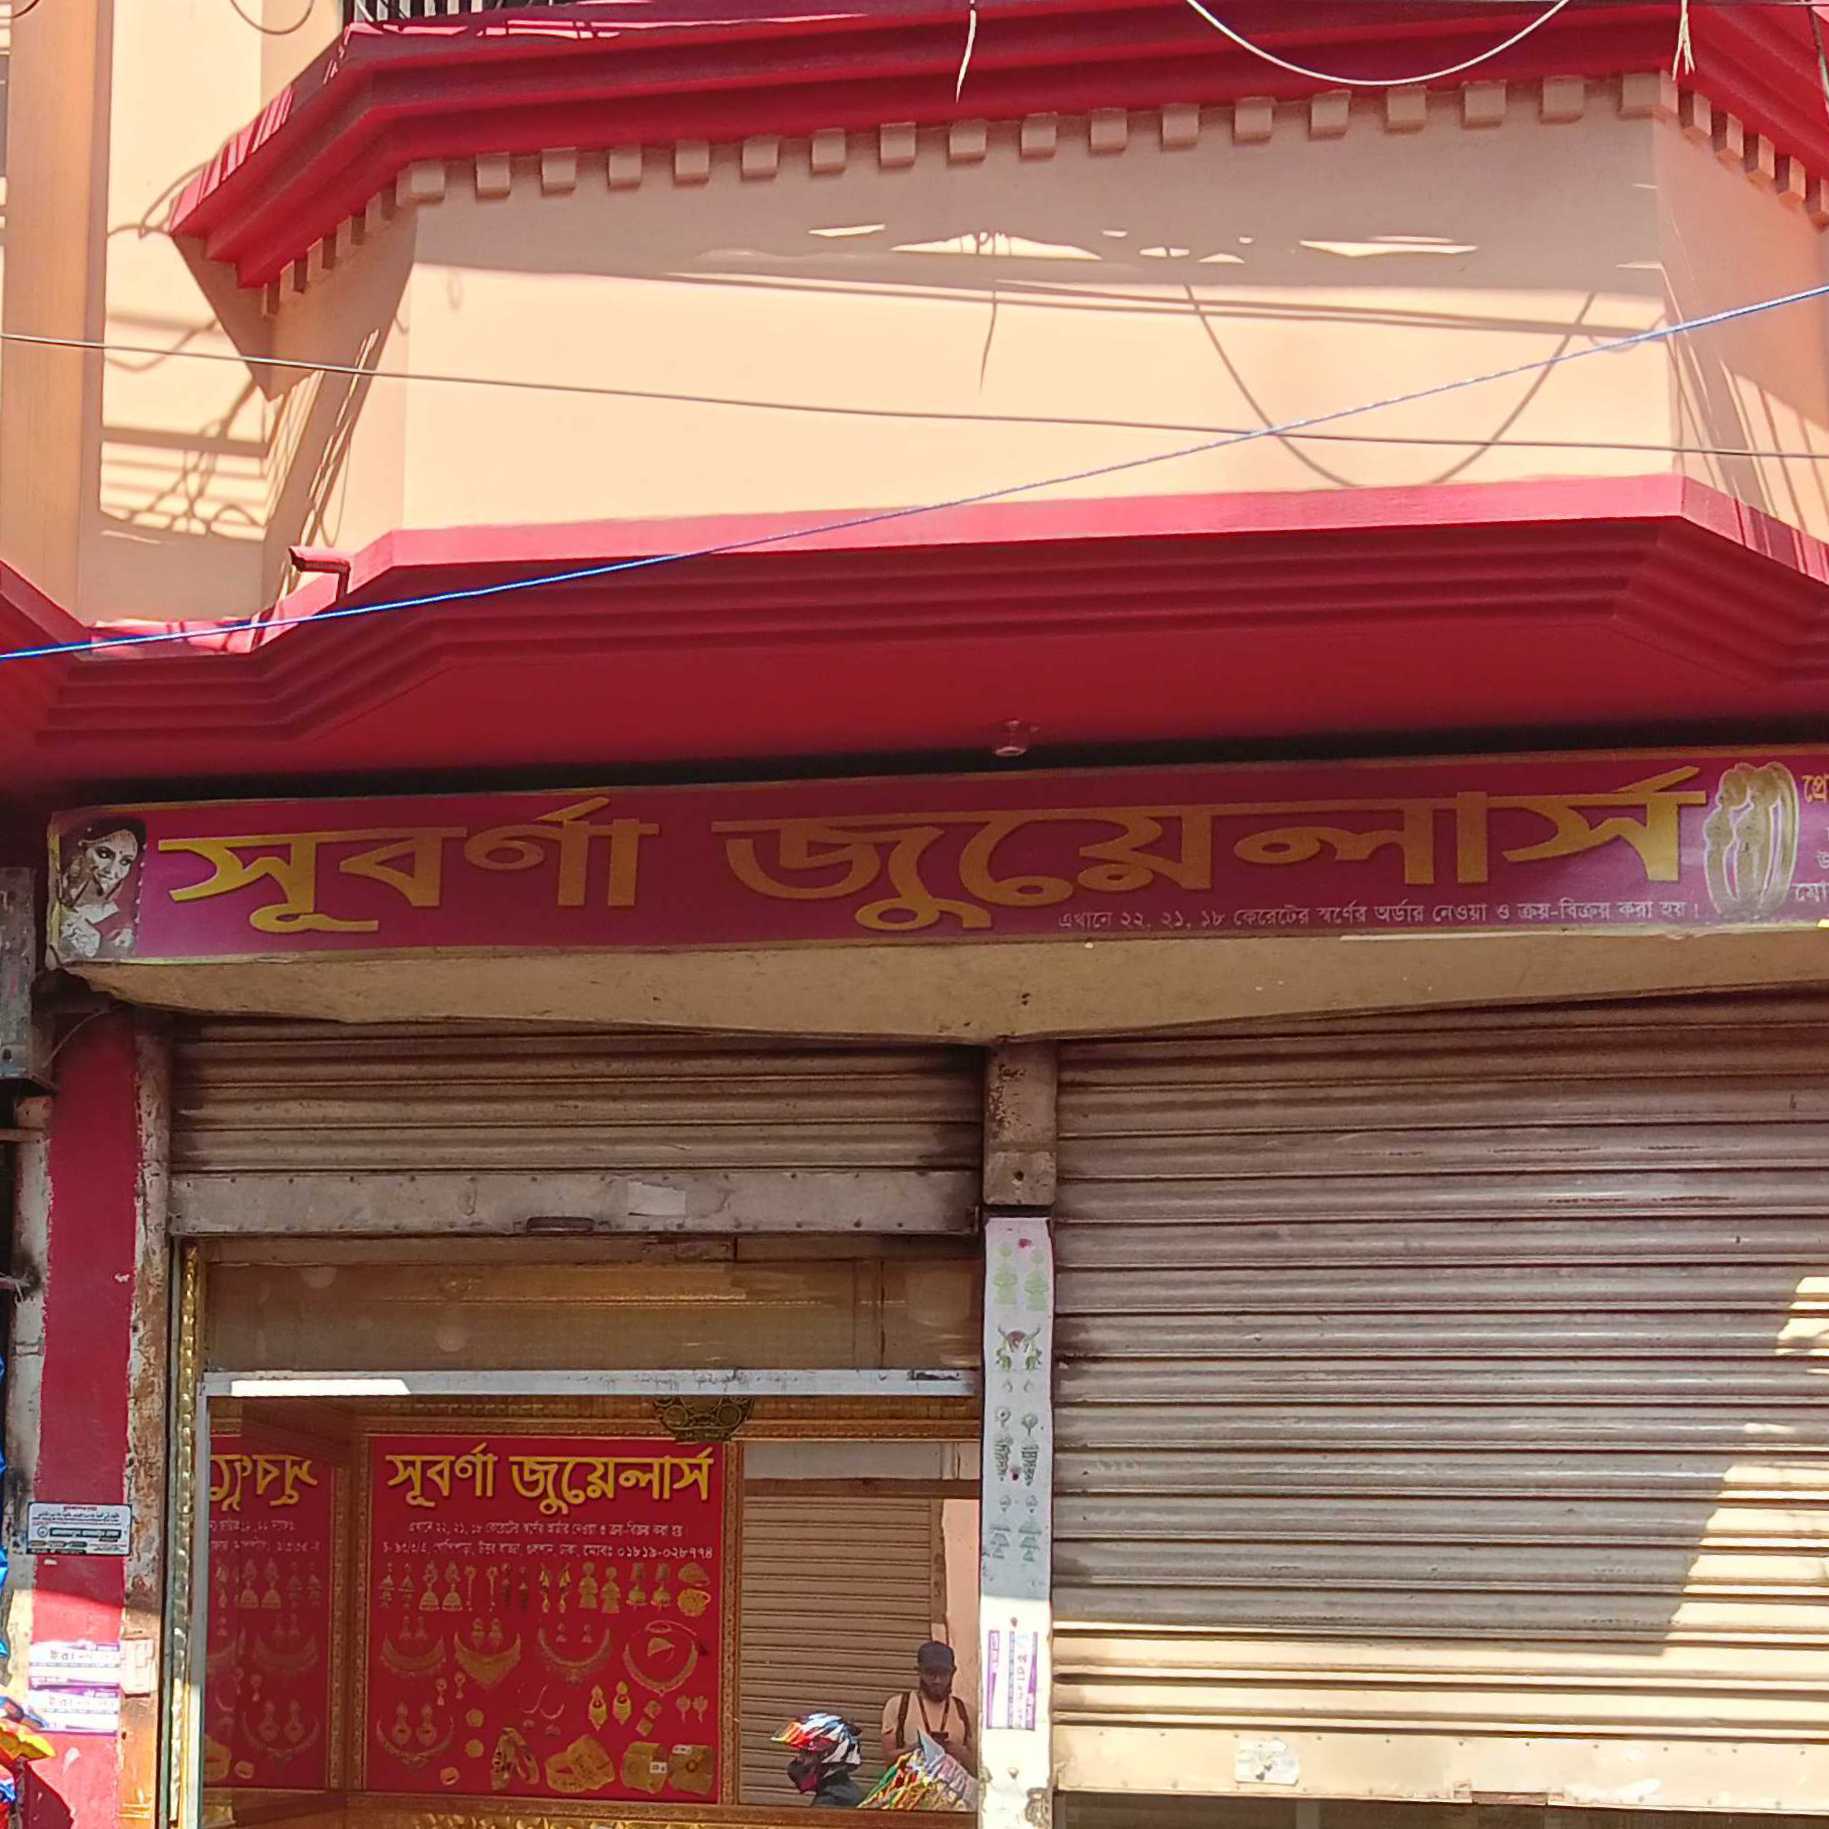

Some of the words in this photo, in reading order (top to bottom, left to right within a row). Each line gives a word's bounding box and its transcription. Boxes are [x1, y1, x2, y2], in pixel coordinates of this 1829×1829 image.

[711, 766, 1706, 931] জুয়েলার্স
[1058, 910, 1112, 929] এখানে
[1201, 909, 1225, 927] ১৮
[1234, 904, 1310, 926] কেরেটের
[1315, 899, 1367, 924] স্বর্ণের
[1374, 898, 1424, 923] অর্ডার
[1432, 903, 1487, 922] নেওয়া
[1498, 904, 1510, 920] ও
[1517, 897, 1610, 920] ক্রয়-বিক্রয়
[1616, 900, 1653, 919] করা
[509, 1444, 714, 1516] জুয়েলার্স
